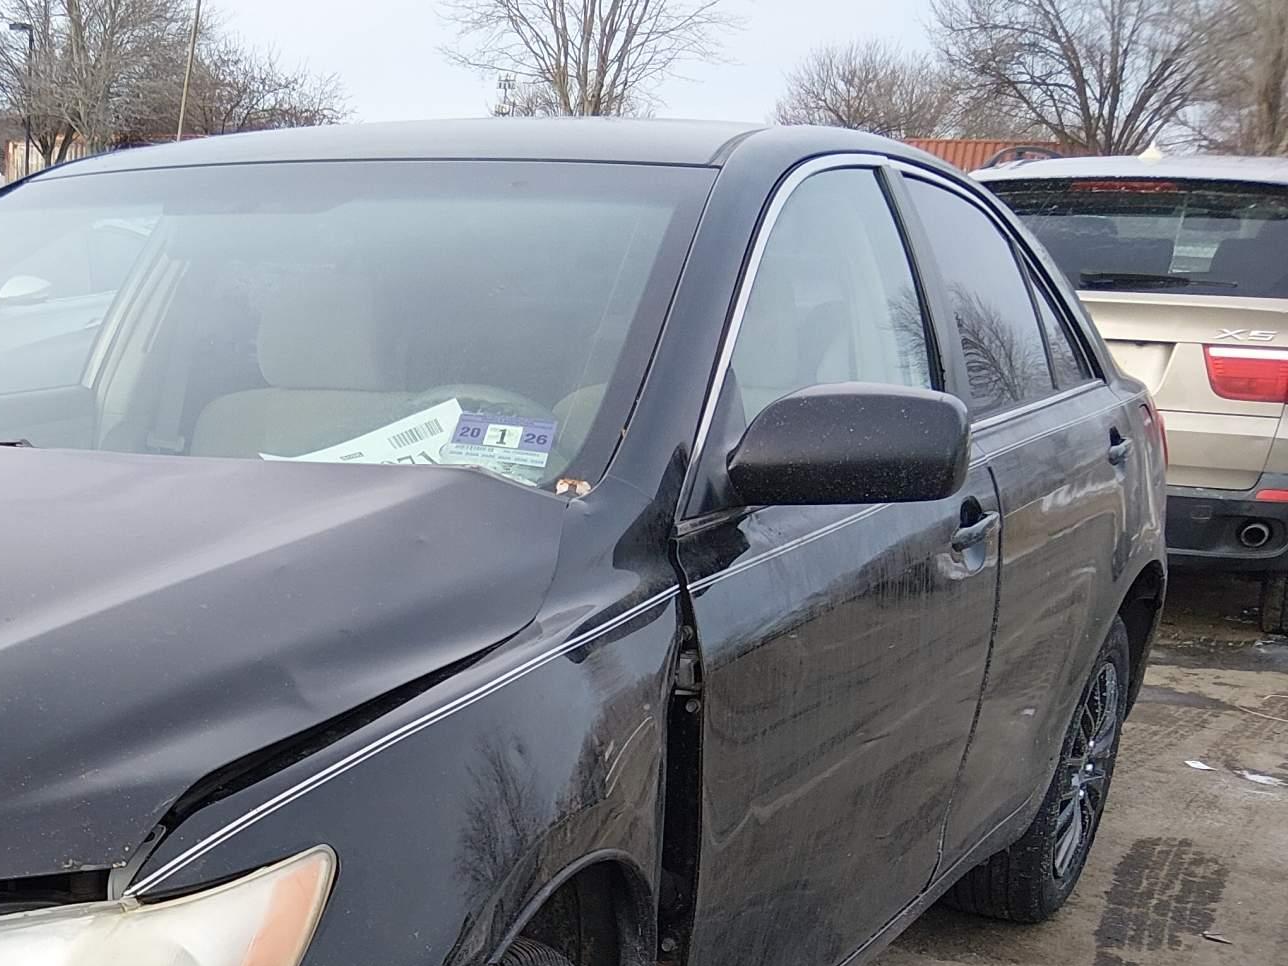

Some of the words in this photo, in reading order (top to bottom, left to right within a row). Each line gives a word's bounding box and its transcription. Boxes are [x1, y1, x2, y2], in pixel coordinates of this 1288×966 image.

[1210, 328, 1279, 341] X5
[459, 426, 481, 438] 20
[495, 428, 508, 445] 1
[523, 432, 548, 445] 26
